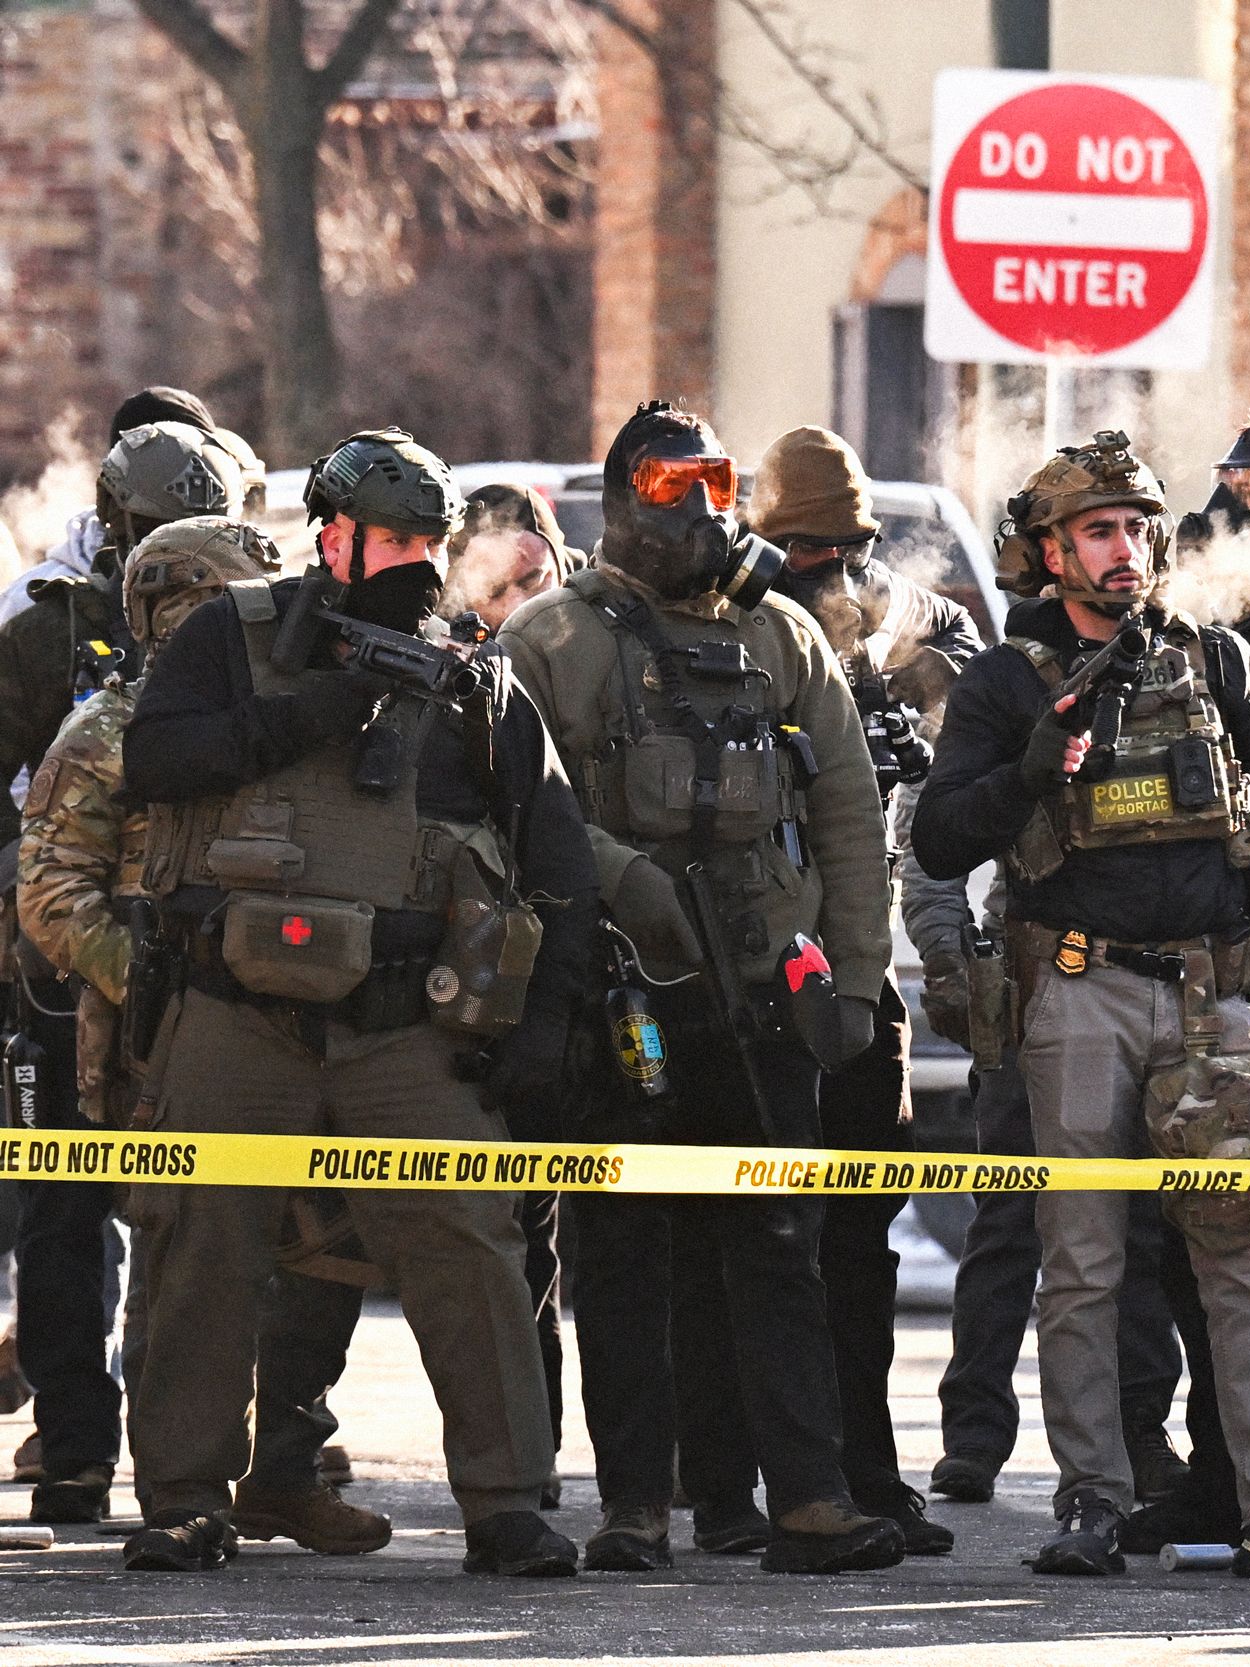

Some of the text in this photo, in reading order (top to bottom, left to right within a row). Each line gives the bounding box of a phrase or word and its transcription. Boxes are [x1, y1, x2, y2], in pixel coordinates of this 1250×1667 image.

[979, 130, 1174, 185] DO NOT
[993, 255, 1147, 309] ENTER
[1094, 778, 1168, 802] POLICE
[1117, 799, 1169, 815] BORTAC
[20, 1087, 36, 1129] ARMY
[28, 1141, 59, 1172] DO
[67, 1142, 114, 1174] NOT
[119, 1143, 196, 1175] CROSS
[308, 1148, 624, 1184] POLICE LINE DO NOT CROSS
[735, 1161, 1050, 1190] POLICE LINE DO NOT CROSS
[1158, 1170, 1242, 1191] POLICE
